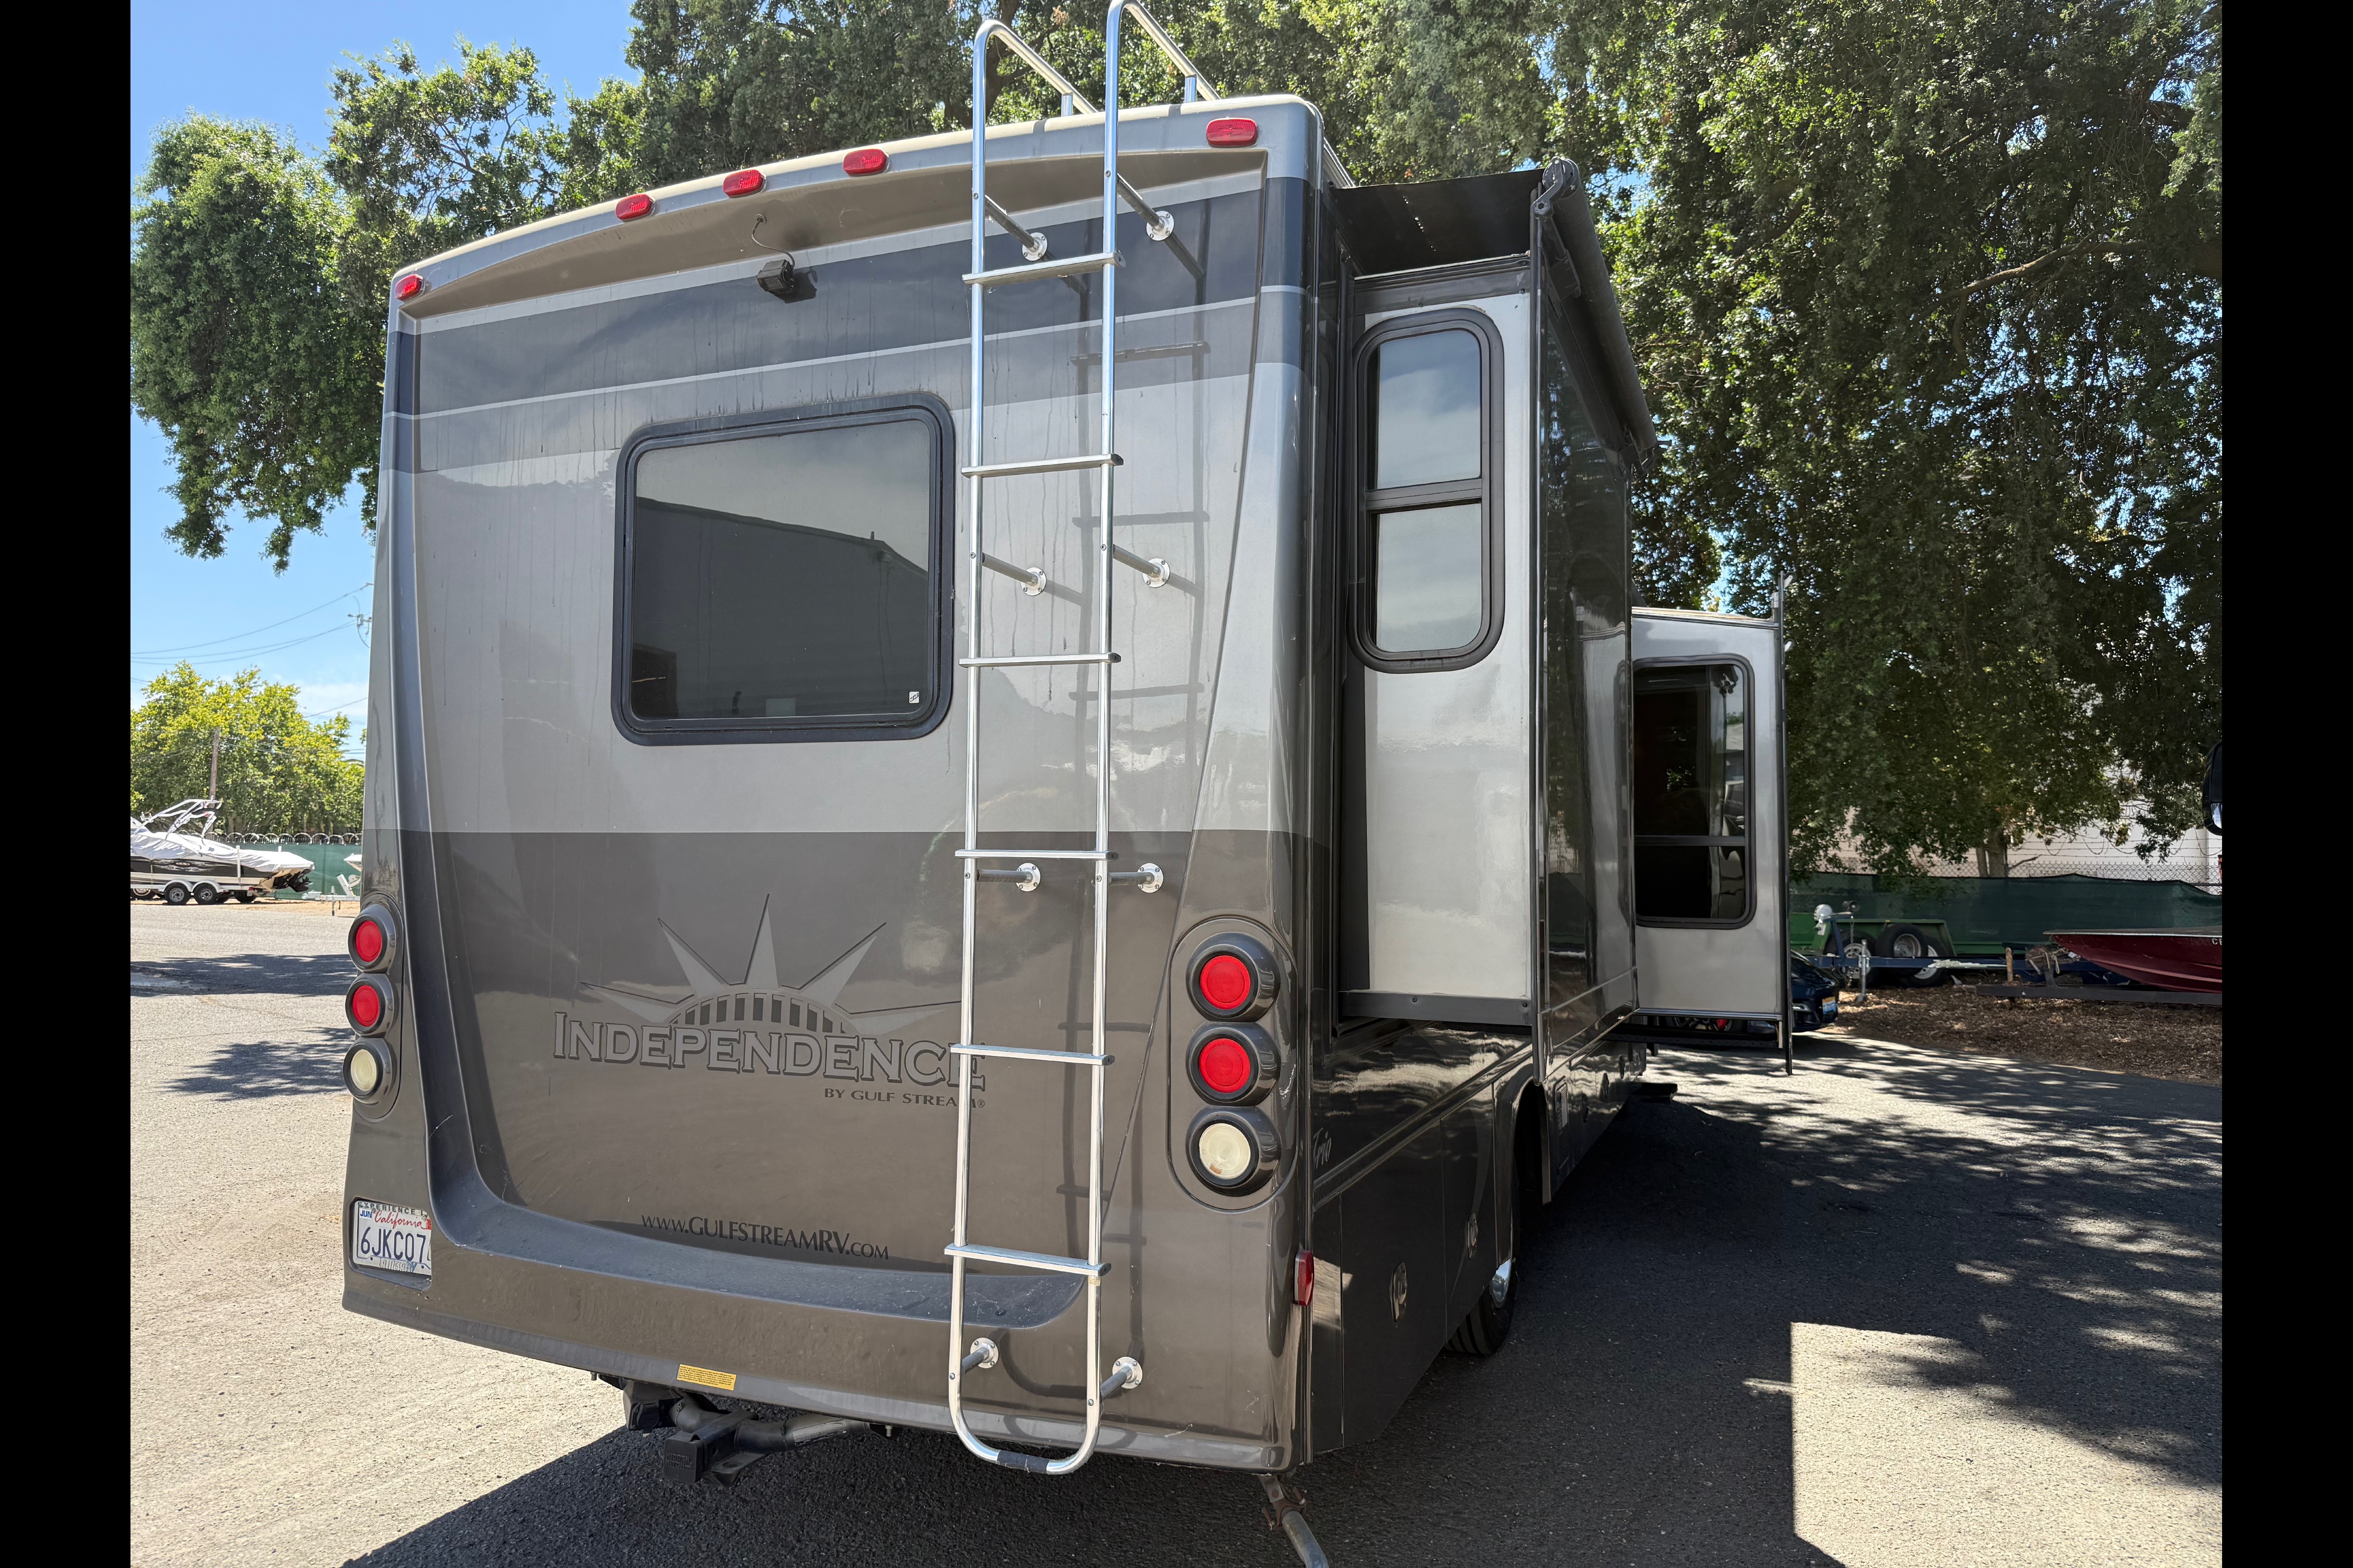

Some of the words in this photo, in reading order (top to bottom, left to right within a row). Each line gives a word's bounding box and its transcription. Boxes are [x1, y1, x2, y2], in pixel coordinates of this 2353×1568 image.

[824, 1088, 845, 1098] BY
[851, 1090, 895, 1102] GULF
[357, 1201, 416, 1215] EXPERIENCE
[360, 1210, 372, 1218] JUN
[375, 1210, 425, 1229] California
[665, 1452, 690, 1463] HIDDEN
